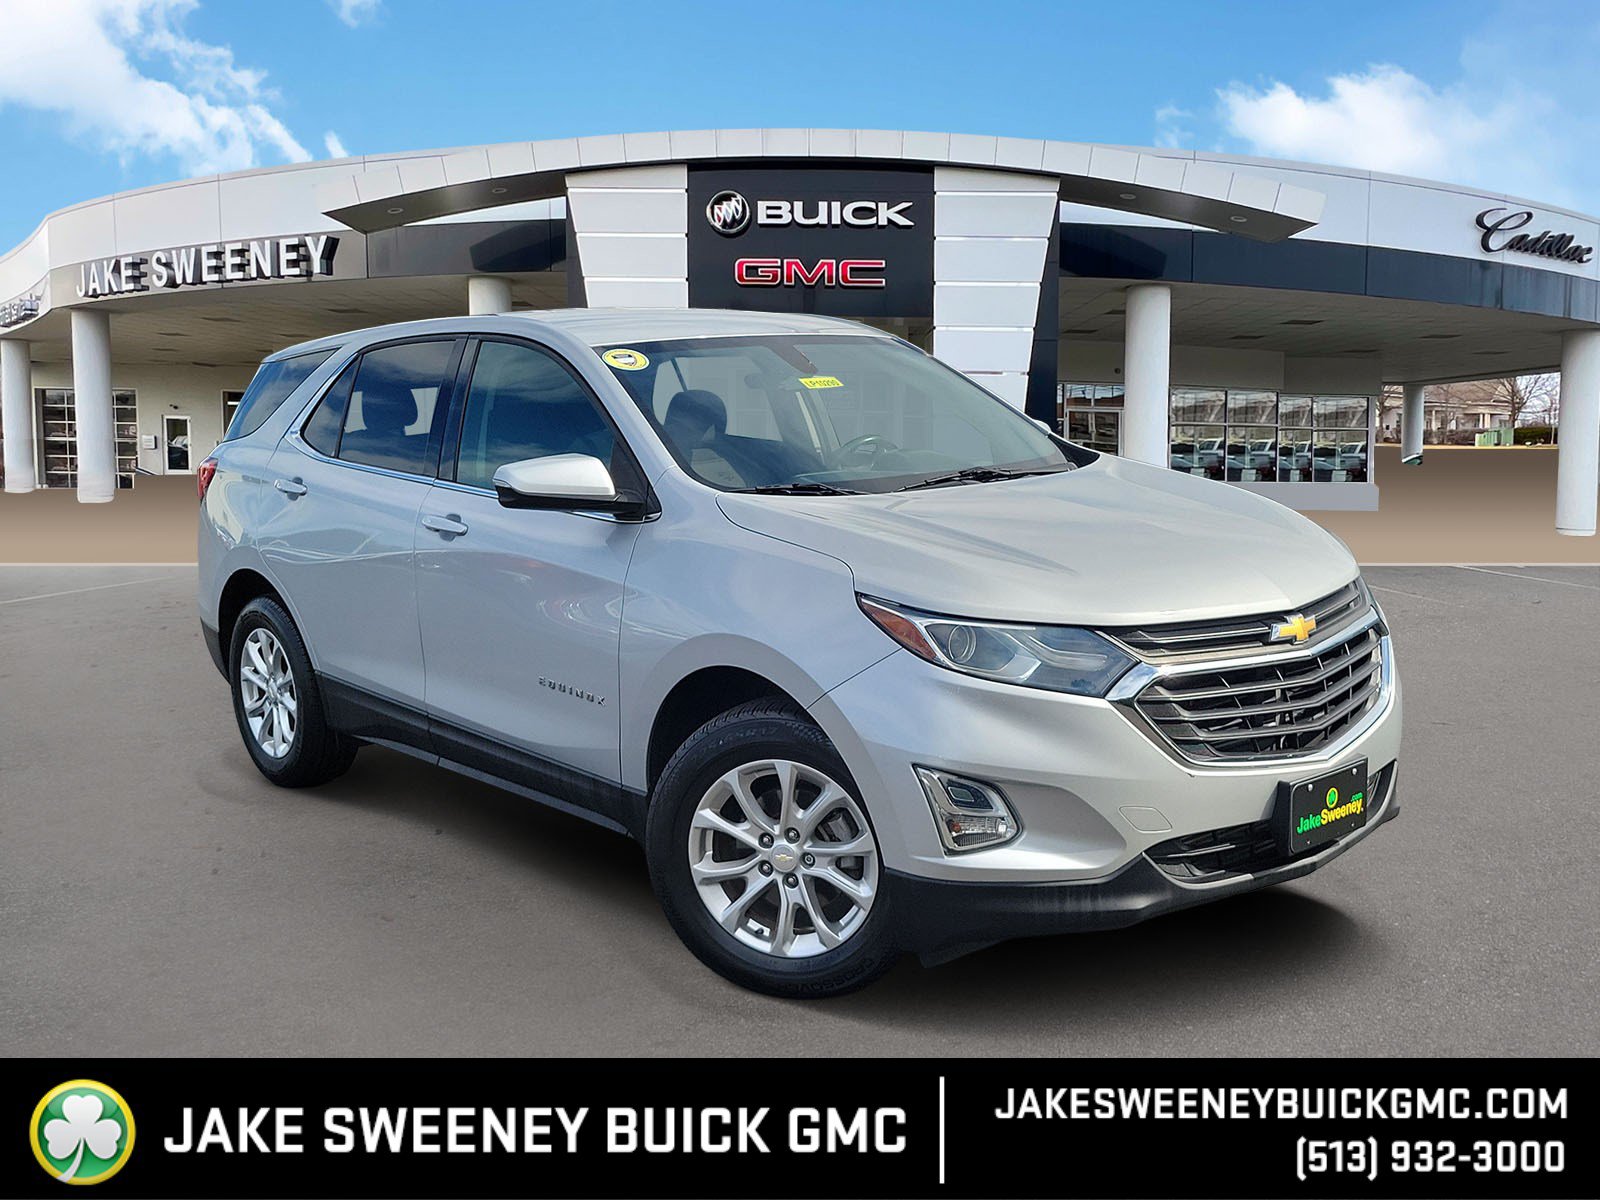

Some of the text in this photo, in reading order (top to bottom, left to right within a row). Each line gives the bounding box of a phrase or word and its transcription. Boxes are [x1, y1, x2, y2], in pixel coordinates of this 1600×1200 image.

[757, 200, 914, 227] BUICK
[1475, 207, 1593, 263] Cadillac
[75, 234, 333, 298] JAKE SWEENEY
[734, 258, 886, 287] GMC
[538, 675, 606, 706] EQUINOX
